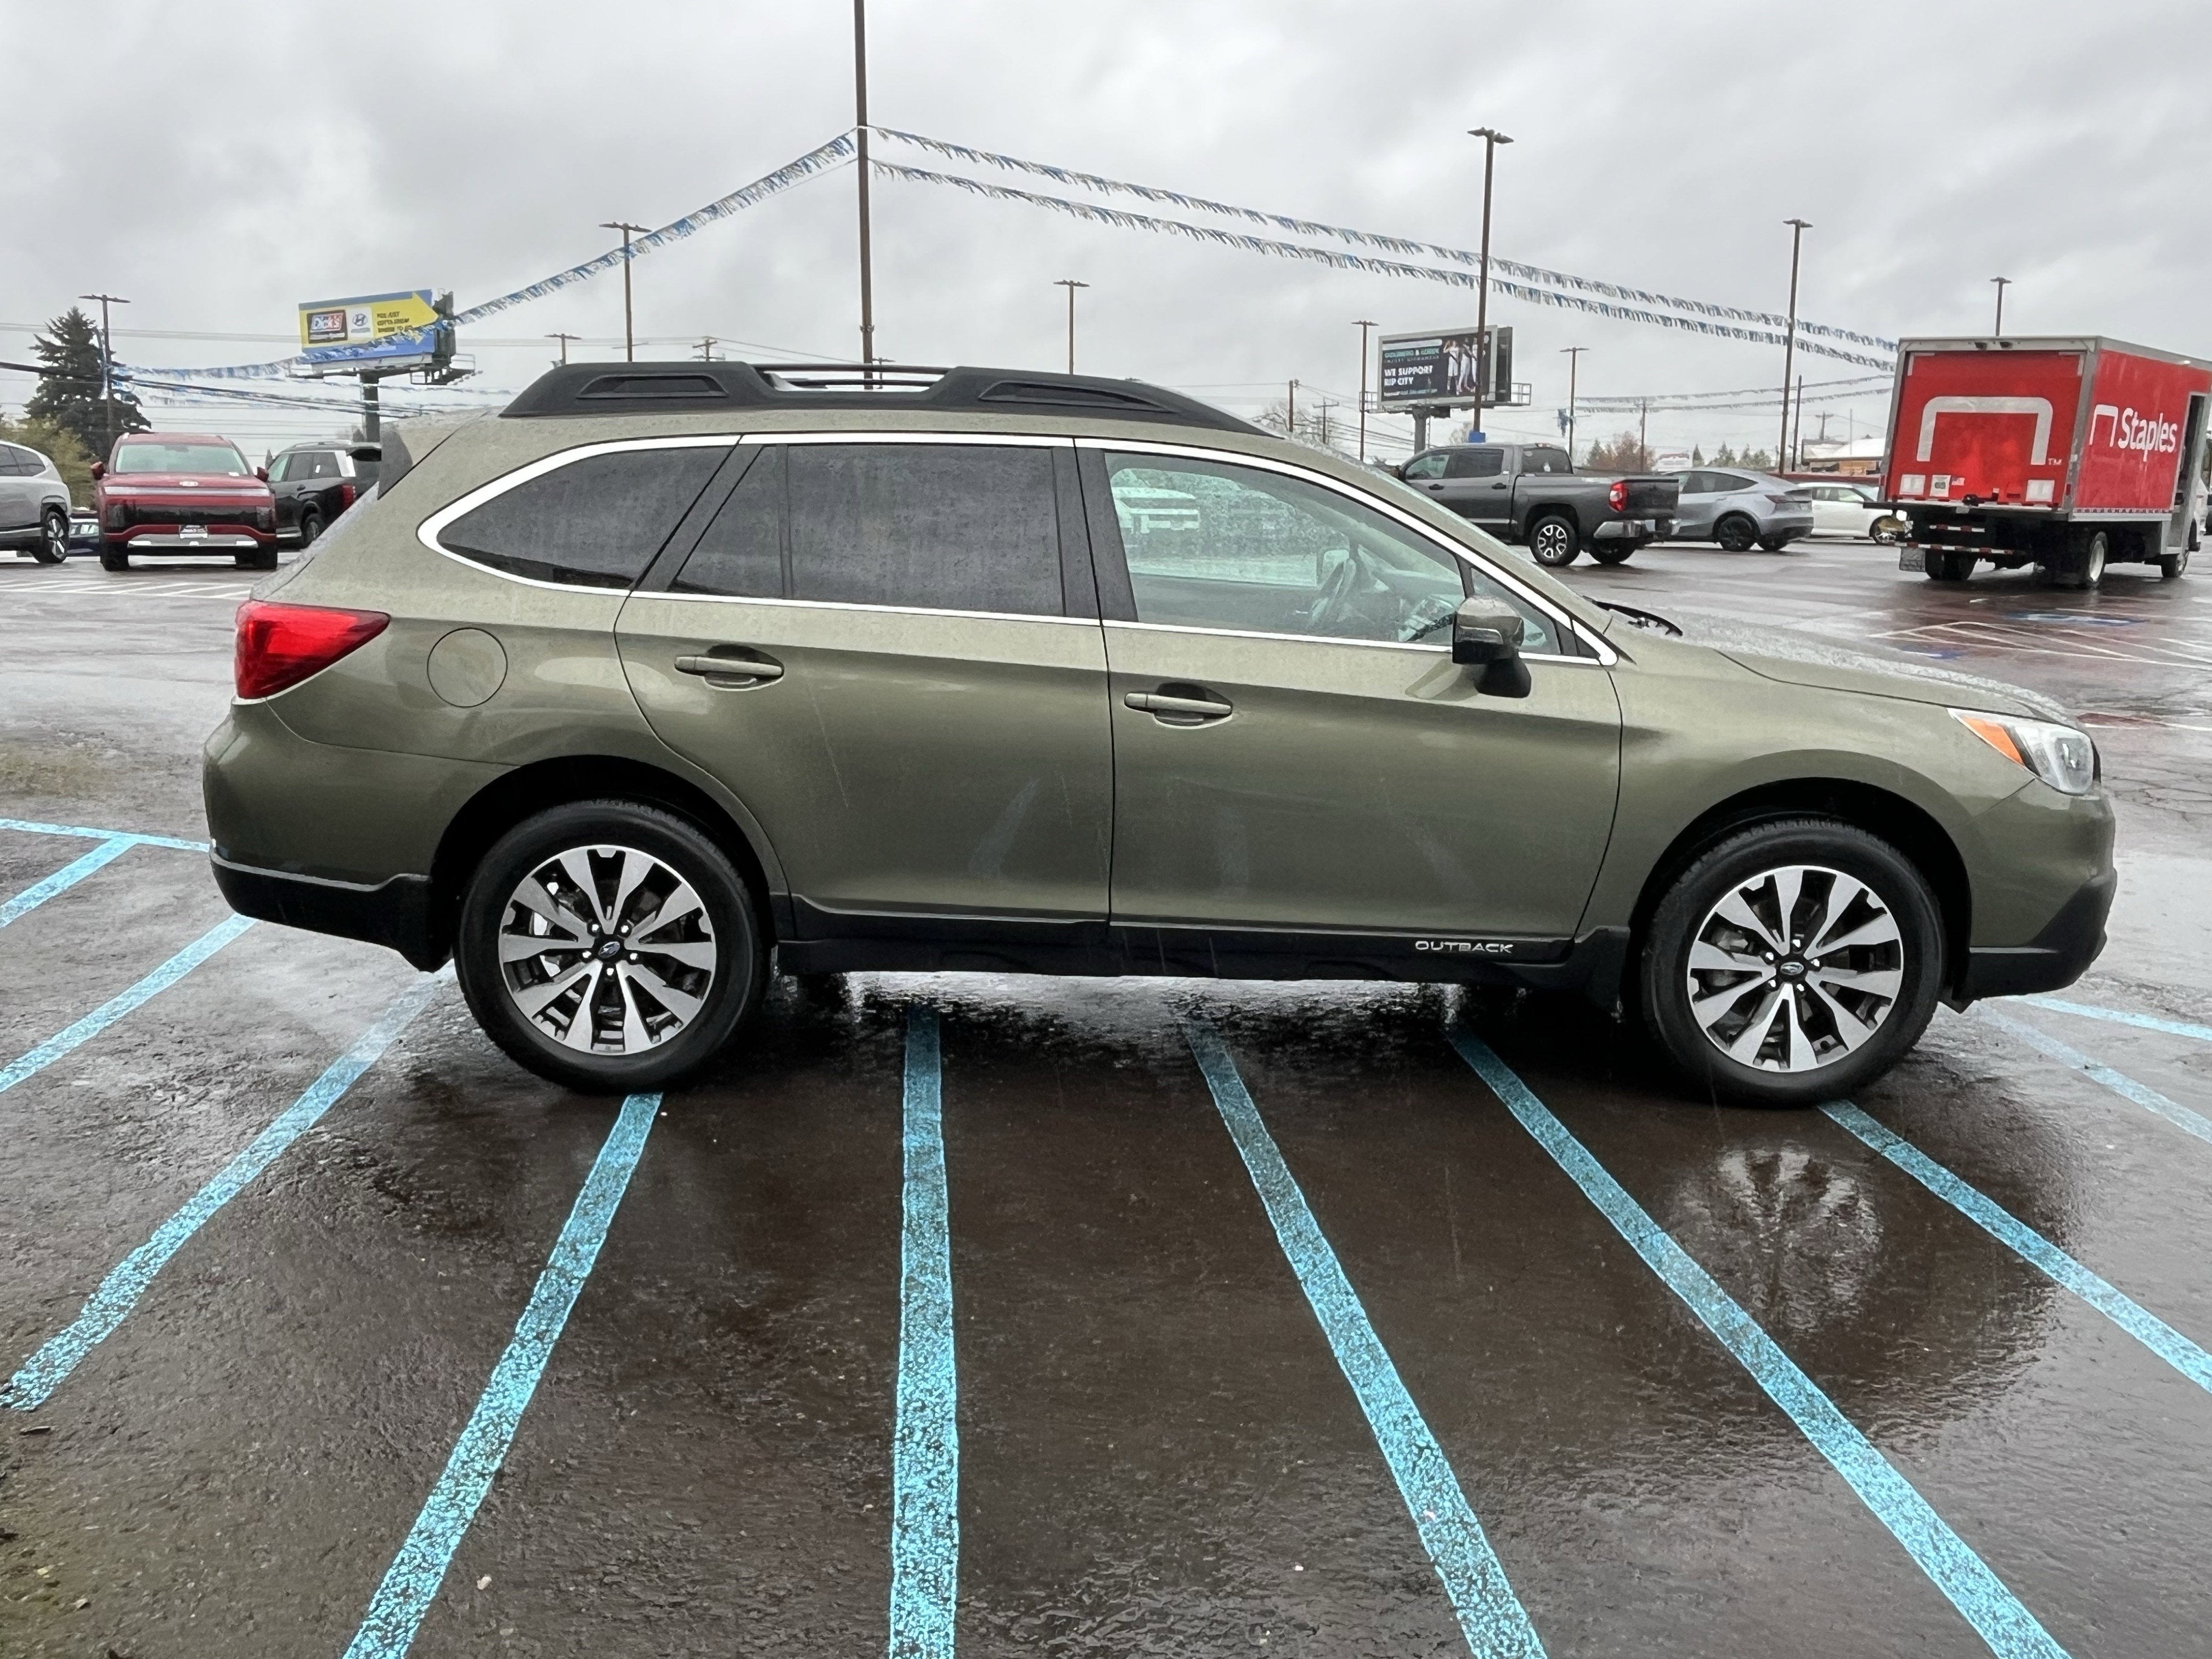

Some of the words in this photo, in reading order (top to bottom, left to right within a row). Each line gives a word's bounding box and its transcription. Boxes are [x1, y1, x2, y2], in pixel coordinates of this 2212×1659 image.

[1398, 365, 1433, 376] SUPPORT
[1397, 376, 1414, 386] CITY
[2118, 407, 2177, 462] Staples
[1415, 940, 1514, 953] OUTBACK
